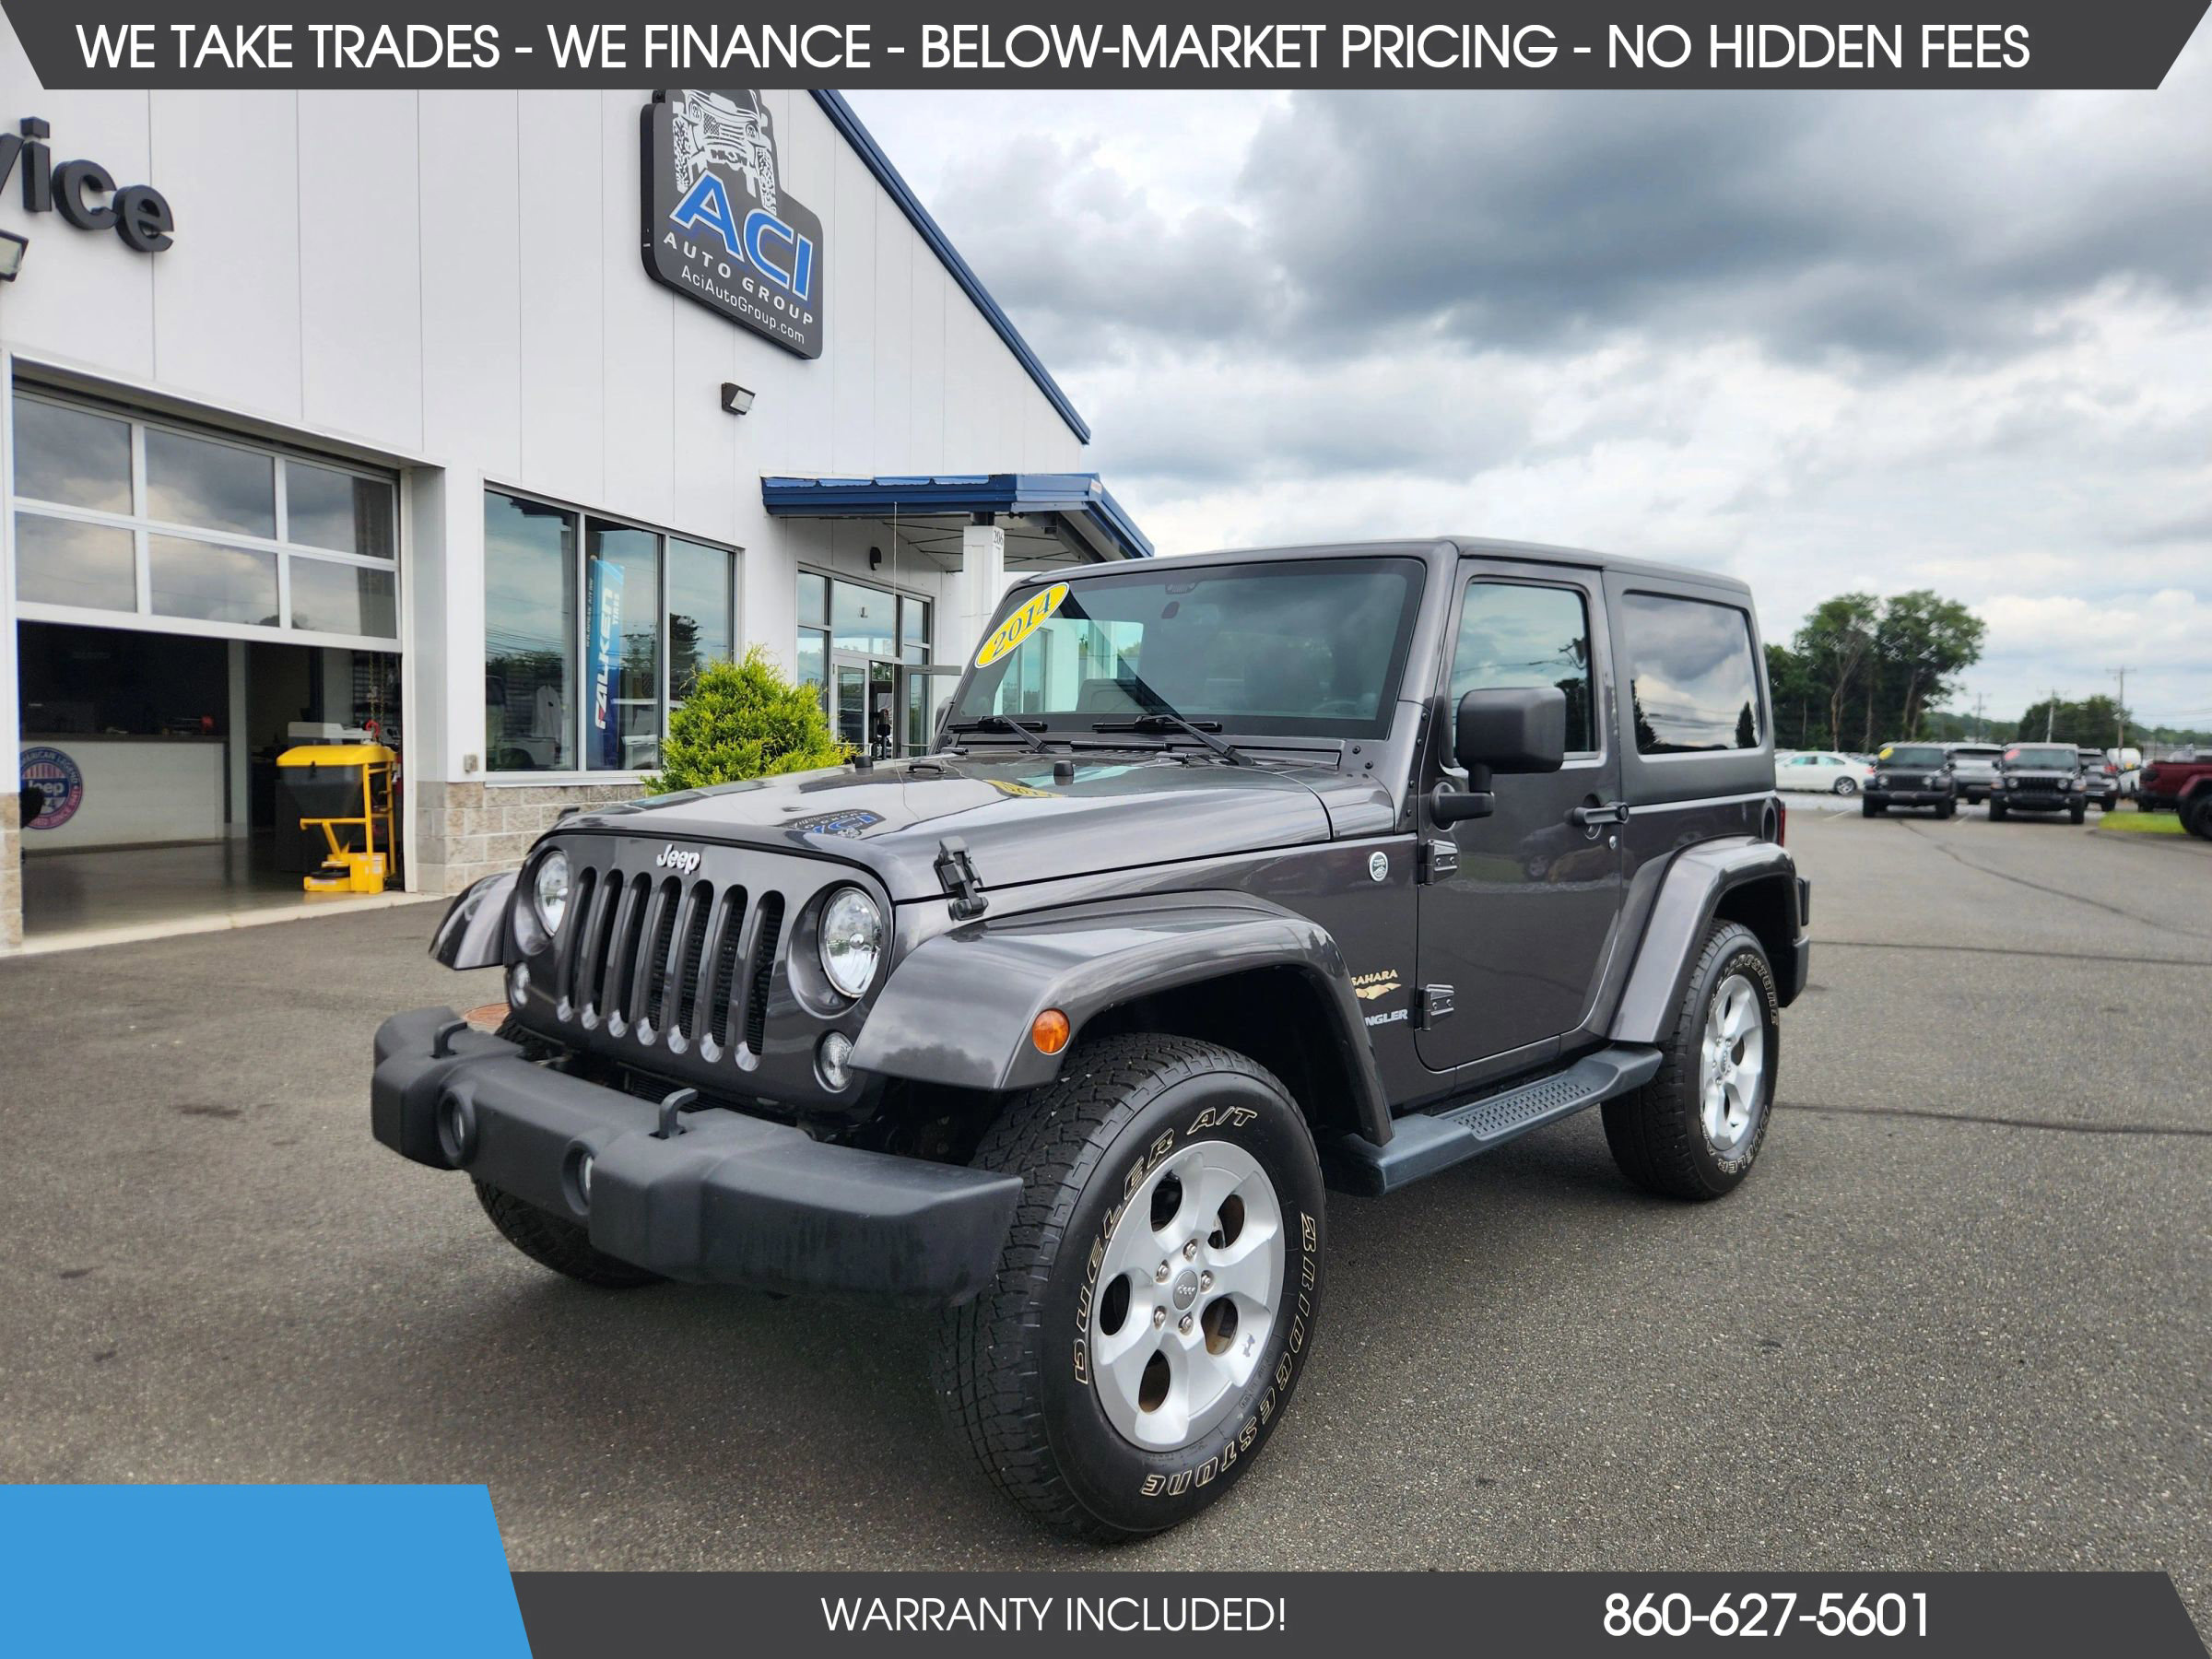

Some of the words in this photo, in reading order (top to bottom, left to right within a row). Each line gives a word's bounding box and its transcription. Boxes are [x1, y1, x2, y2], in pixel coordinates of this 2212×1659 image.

[663, 231, 731, 278] AUTO
[742, 276, 813, 324] GROUP
[669, 169, 813, 301] ACI
[681, 265, 805, 344] AciAutoGroup.com
[594, 588, 614, 730] FALKEN
[992, 589, 1052, 658] 2014
[655, 843, 700, 876] Jeep
[1364, 1008, 1408, 1026] NGLER
[1073, 1128, 1174, 1384] DUELER
[1186, 1106, 1257, 1135] A/T
[1141, 1211, 1316, 1496] BRIDGESTONE
